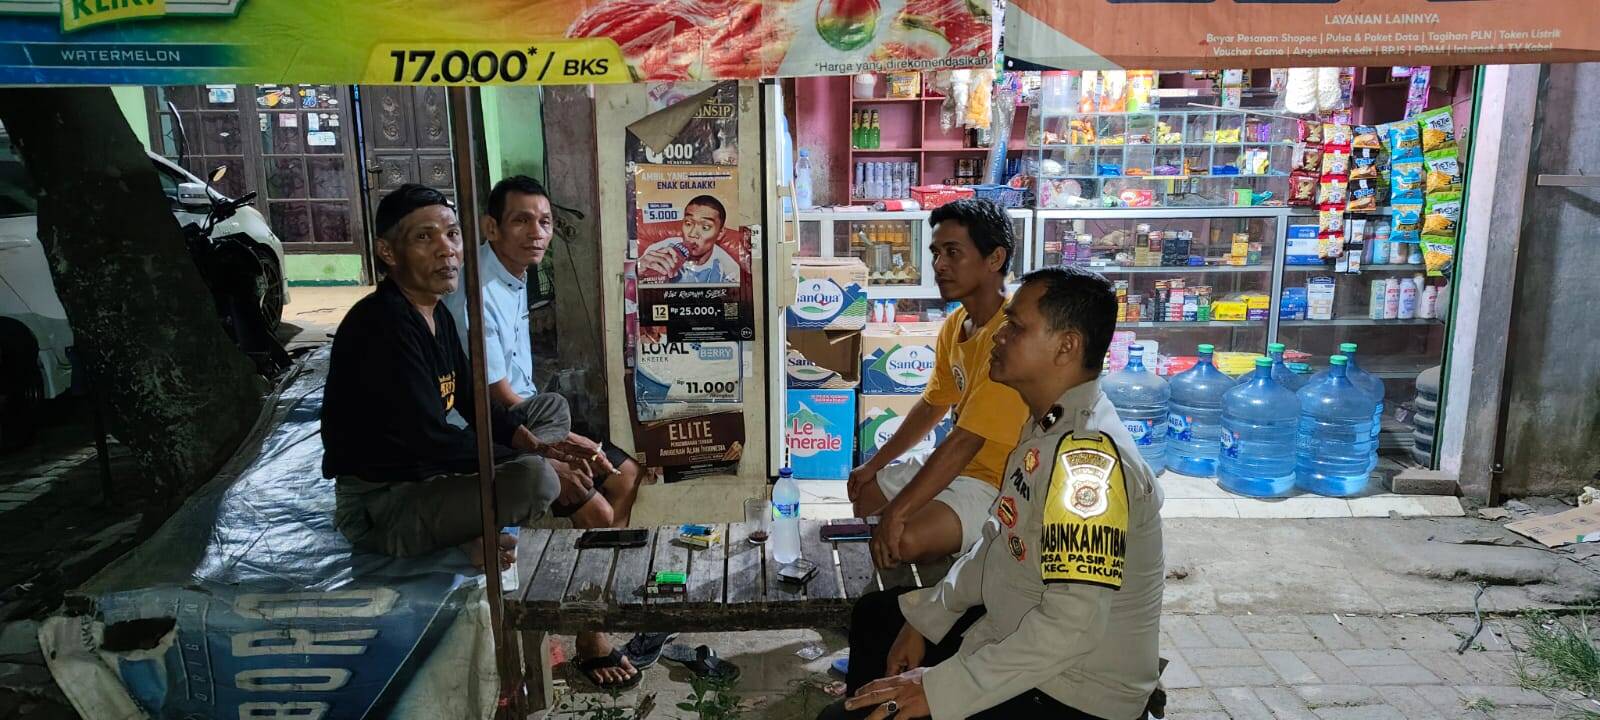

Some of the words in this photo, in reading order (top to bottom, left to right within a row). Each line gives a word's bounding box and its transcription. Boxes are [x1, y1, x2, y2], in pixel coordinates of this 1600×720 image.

[1325, 14, 1382, 25] LAYANAN
[1386, 13, 1440, 24] LAINNYA
[1206, 33, 1235, 45] Bayar
[1237, 32, 1280, 43] Pesanan
[1281, 32, 1317, 45] Shopee
[1325, 32, 1351, 42] Pulsa
[1364, 32, 1392, 42] Paket
[1395, 31, 1419, 41] Data
[1428, 31, 1469, 43] Tagihan
[1471, 30, 1492, 40] PLN
[1499, 30, 1529, 39] Token
[1531, 28, 1562, 38] Listrik
[61, 50, 181, 62] WATERMELON
[1213, 47, 1252, 56] Voucher
[1255, 46, 1284, 56] Game
[1294, 46, 1340, 57] Angsuran
[1342, 46, 1373, 55] Kredit
[1381, 45, 1406, 54] BPJS
[563, 59, 609, 76] BKS
[855, 60, 883, 73] yang
[886, 55, 989, 70] direkomendasikan
[656, 181, 678, 190] ENAK
[680, 180, 716, 190] GILAAKK!
[649, 210, 678, 220] 5.000
[797, 291, 839, 306] anQua
[655, 307, 666, 316] 12
[670, 307, 679, 315] Rp
[679, 306, 722, 317] 25.000,-
[641, 342, 690, 355] LOYAL
[700, 347, 732, 358] BERRY
[668, 420, 713, 440] ELITE
[793, 419, 814, 435] Le
[786, 434, 841, 450] inerale
[1010, 467, 1030, 502] POLRI
[1068, 553, 1106, 566] PASIR
[1111, 559, 1124, 569] JAT
[1044, 563, 1069, 573] KEC.
[1076, 564, 1123, 580] CIKUPA
